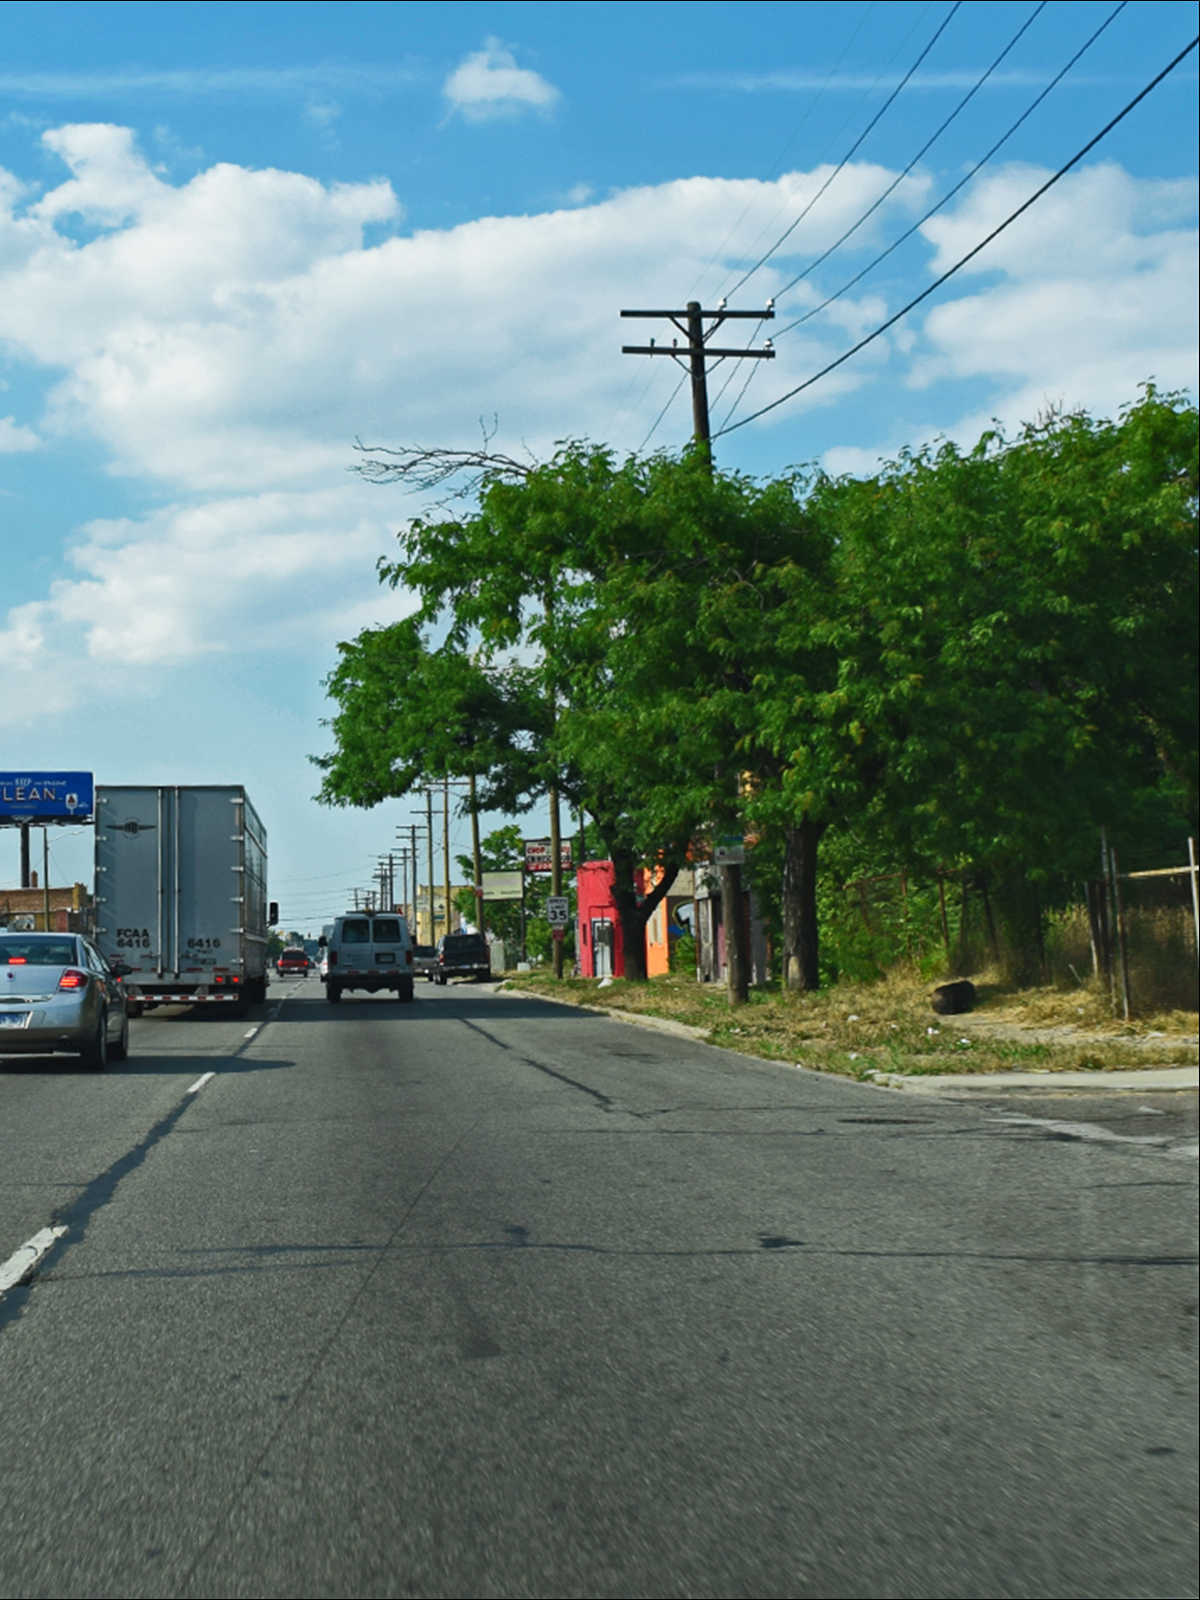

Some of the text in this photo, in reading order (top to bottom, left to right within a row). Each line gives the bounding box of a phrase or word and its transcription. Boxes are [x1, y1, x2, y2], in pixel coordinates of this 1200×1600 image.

[550, 910, 567, 921] 35
[116, 929, 150, 938] FCAA
[117, 938, 150, 948] 6416
[187, 938, 220, 948] 6416
